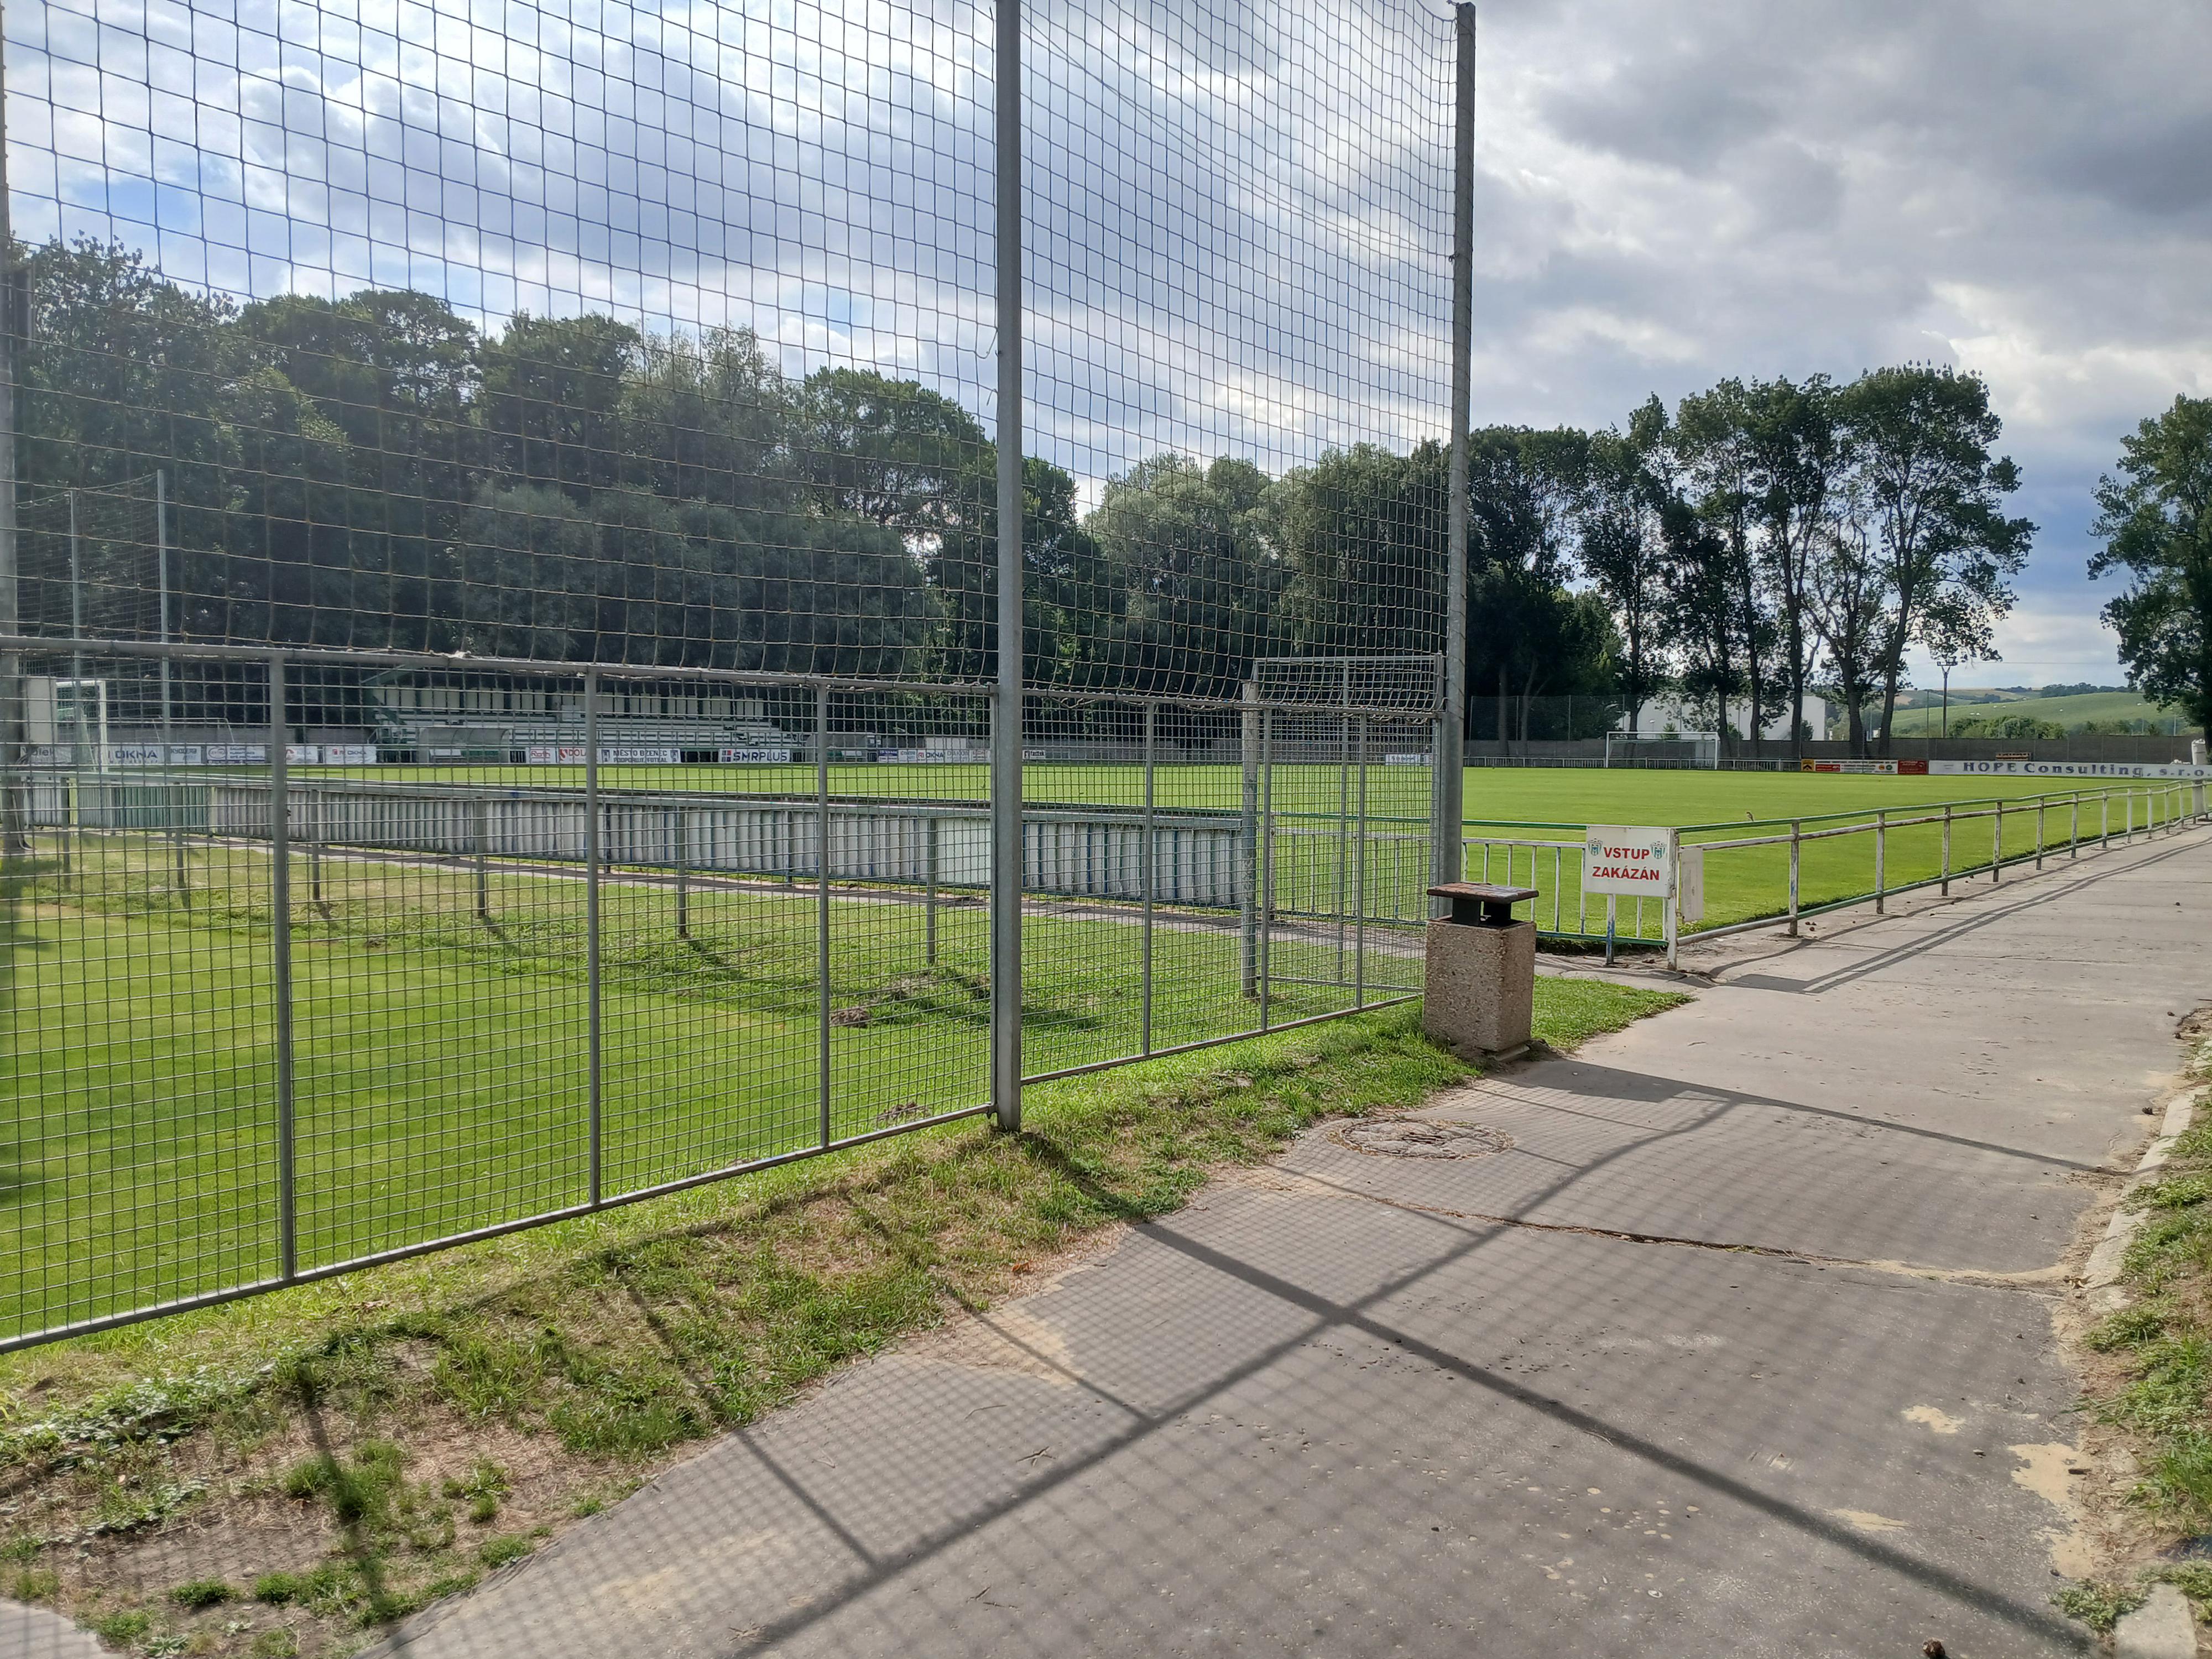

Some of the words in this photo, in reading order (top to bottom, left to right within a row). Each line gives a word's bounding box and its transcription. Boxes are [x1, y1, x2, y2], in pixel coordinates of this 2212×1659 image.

[115, 750, 158, 758] OKNA
[733, 752, 787, 761] SMRPLUS
[1963, 762, 2017, 772] HOPE
[2024, 763, 2151, 778] Consulting,
[2159, 768, 2211, 777] s.r.o.
[1604, 847, 1650, 859] VSTUP
[1592, 865, 1660, 881] ZAKÁZÁN
